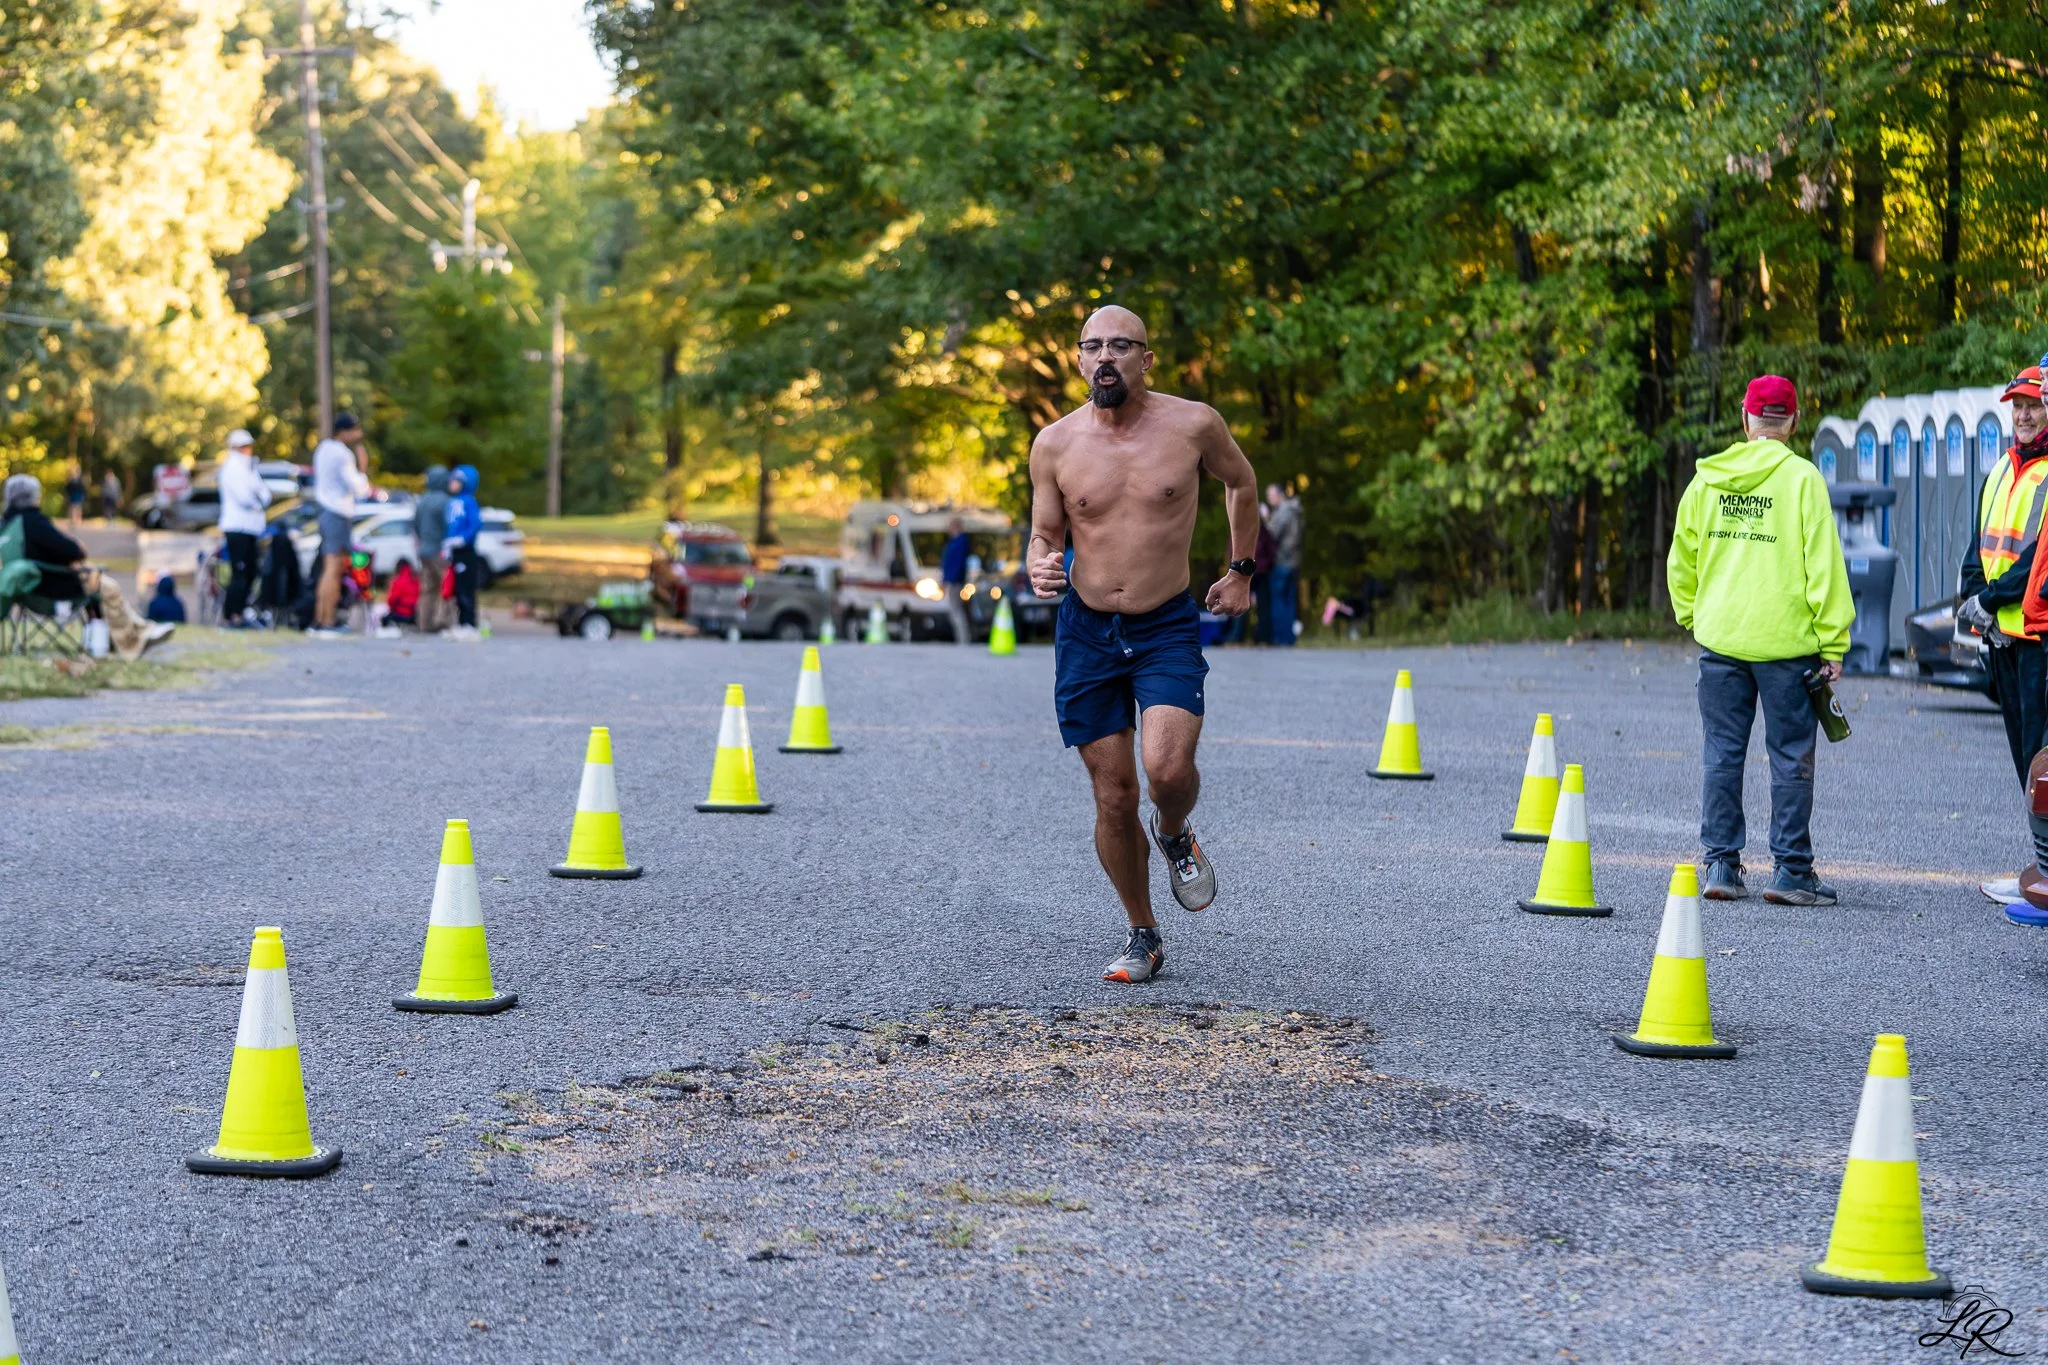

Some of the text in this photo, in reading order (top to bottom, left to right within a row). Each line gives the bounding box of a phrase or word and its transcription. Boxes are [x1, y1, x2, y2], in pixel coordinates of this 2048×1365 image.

[1719, 494, 1773, 509] MEMPHIS
[1722, 506, 1764, 517] RUNNERS
[1750, 533, 1777, 543] CREW
